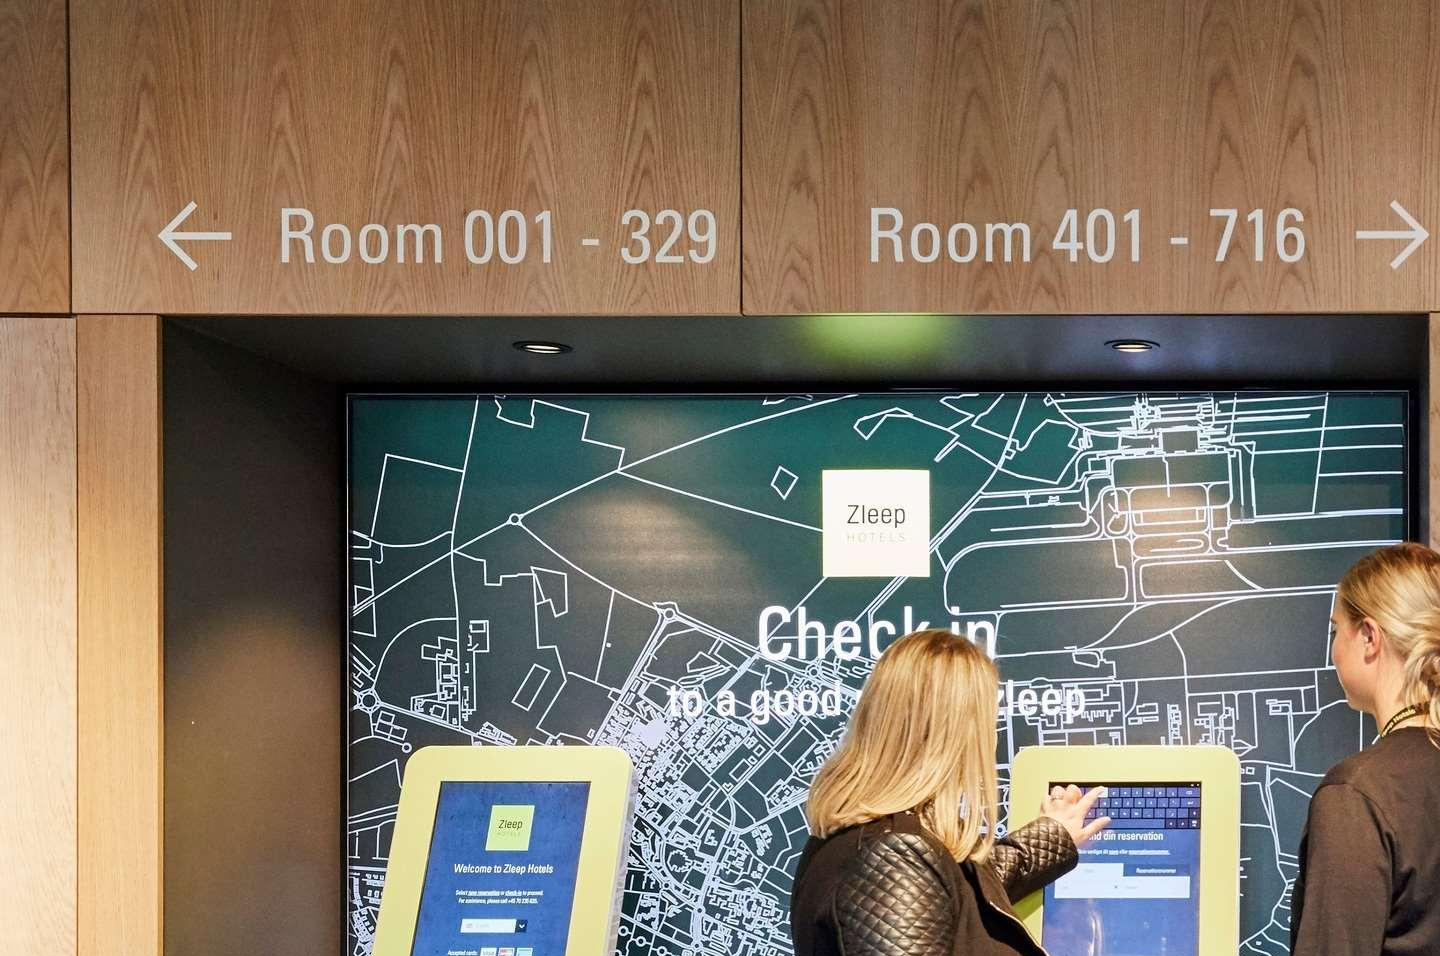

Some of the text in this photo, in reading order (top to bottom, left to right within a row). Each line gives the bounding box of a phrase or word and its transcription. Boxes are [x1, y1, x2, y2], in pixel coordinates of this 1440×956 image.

[281, 207, 717, 265] Room 001 - 329
[869, 207, 1306, 263] Room 401 - 716
[846, 504, 907, 528] Zleep
[845, 533, 907, 544] HOTELS
[667, 680, 1086, 725] to a good leep
[498, 819, 523, 830] Zleep
[1104, 831, 1116, 841] din
[1118, 831, 1164, 841] reservation
[454, 863, 554, 875] Welcome to Zleep Hotels
